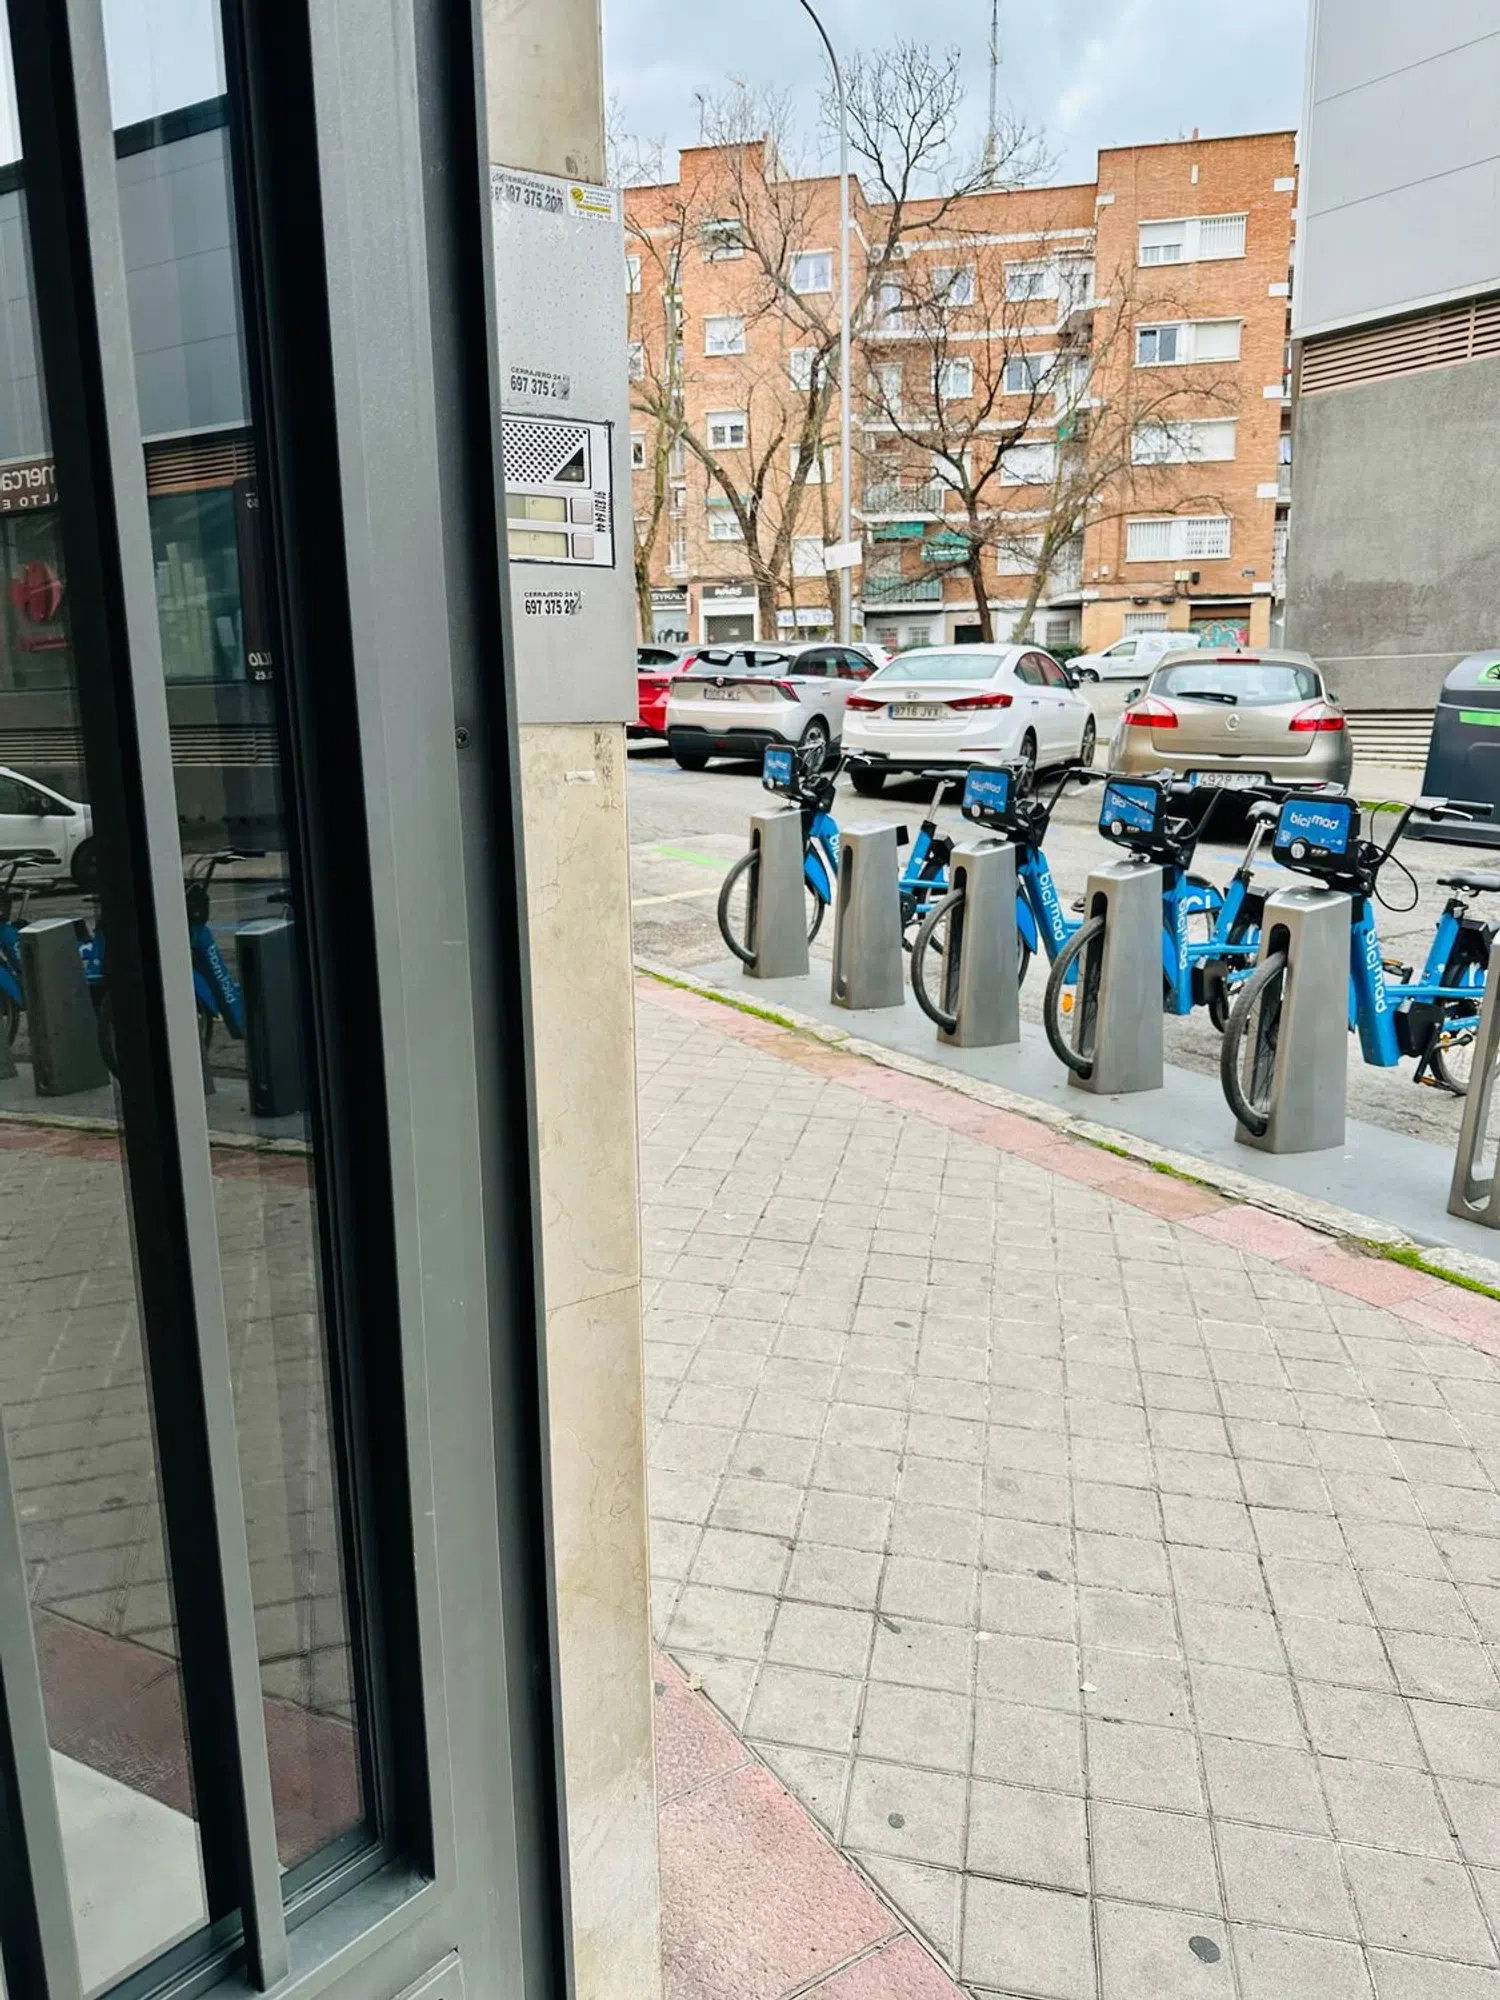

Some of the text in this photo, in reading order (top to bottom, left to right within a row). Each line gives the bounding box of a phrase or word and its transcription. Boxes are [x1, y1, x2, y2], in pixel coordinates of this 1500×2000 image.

[524, 188, 542, 208] 375
[511, 366, 552, 379] CERRAJERO
[511, 374, 528, 392] 697
[531, 378, 549, 396] 375
[525, 599, 542, 615] 697
[545, 599, 563, 615] 375
[894, 706, 939, 717] 9716 JVX
